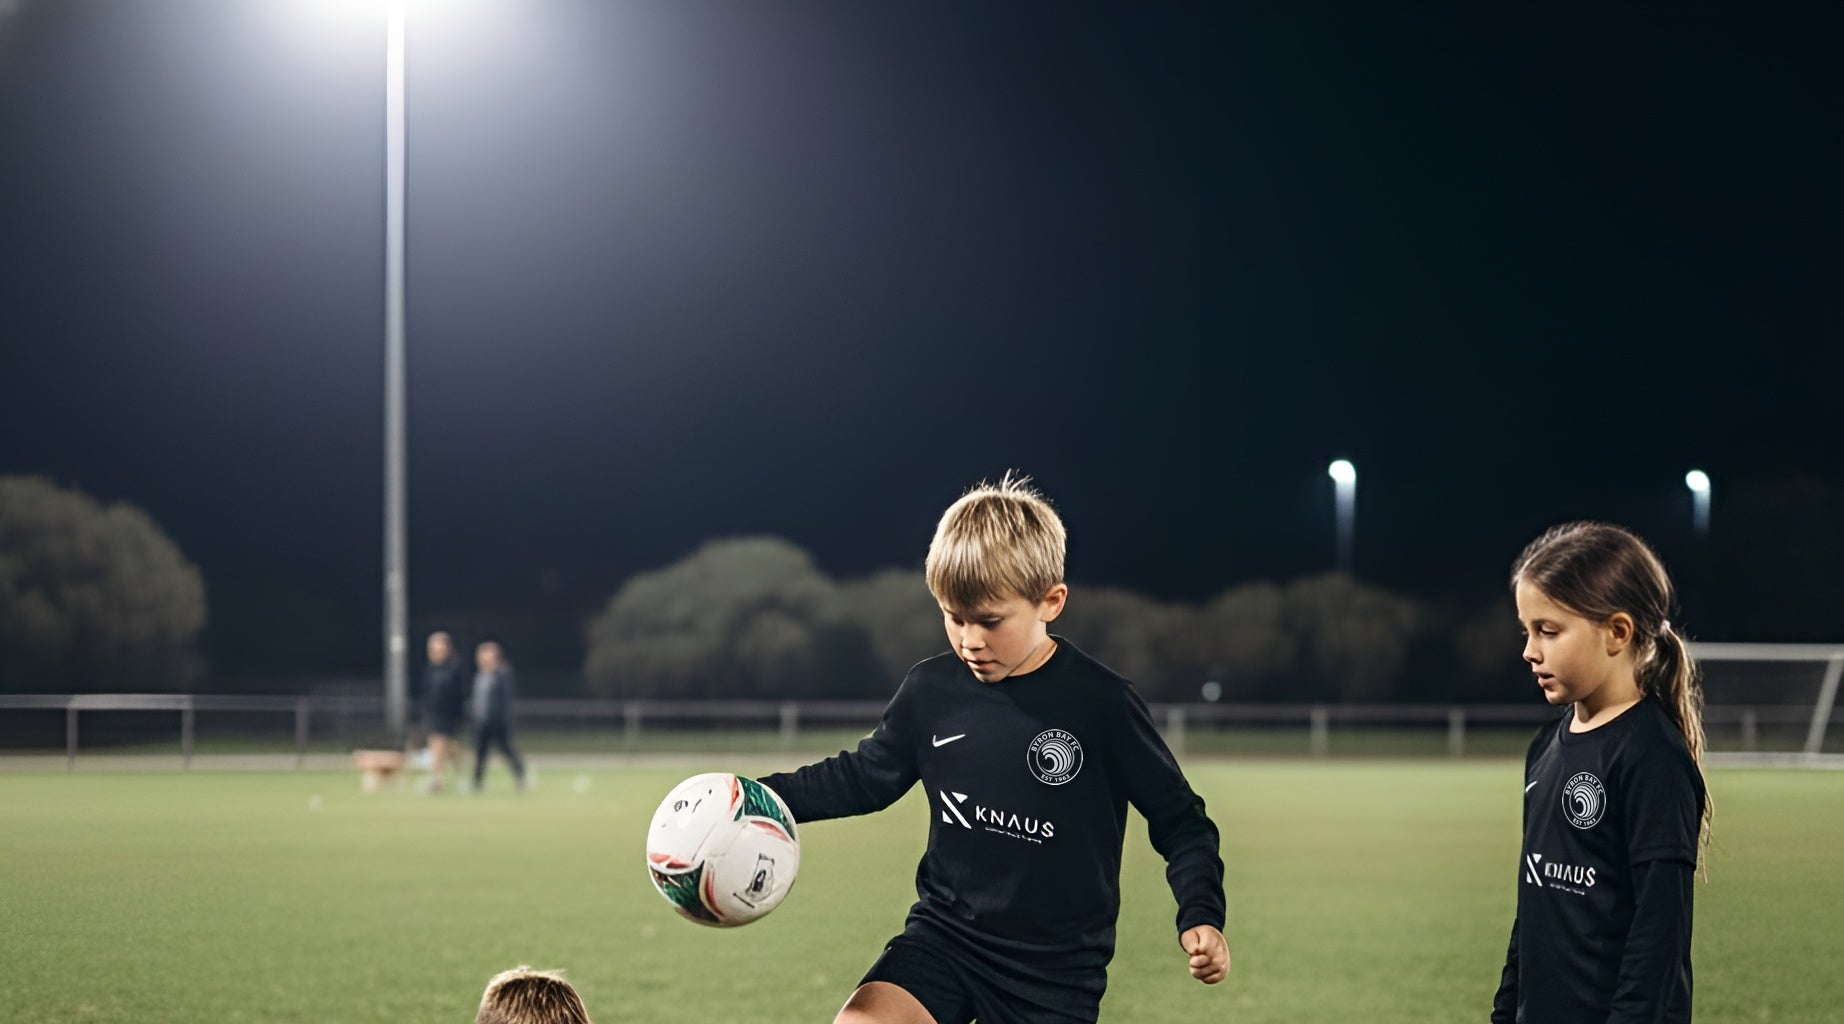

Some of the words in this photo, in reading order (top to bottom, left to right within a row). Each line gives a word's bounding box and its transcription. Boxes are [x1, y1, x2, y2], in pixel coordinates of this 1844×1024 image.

[1031, 732, 1054, 752] BYRON
[1056, 731, 1072, 741] BAY
[1070, 741, 1080, 752] FC
[1041, 774, 1053, 782] EST
[1565, 775, 1583, 795] BYRON
[1584, 775, 1597, 785] BAY
[976, 805, 1055, 838] KNAUS
